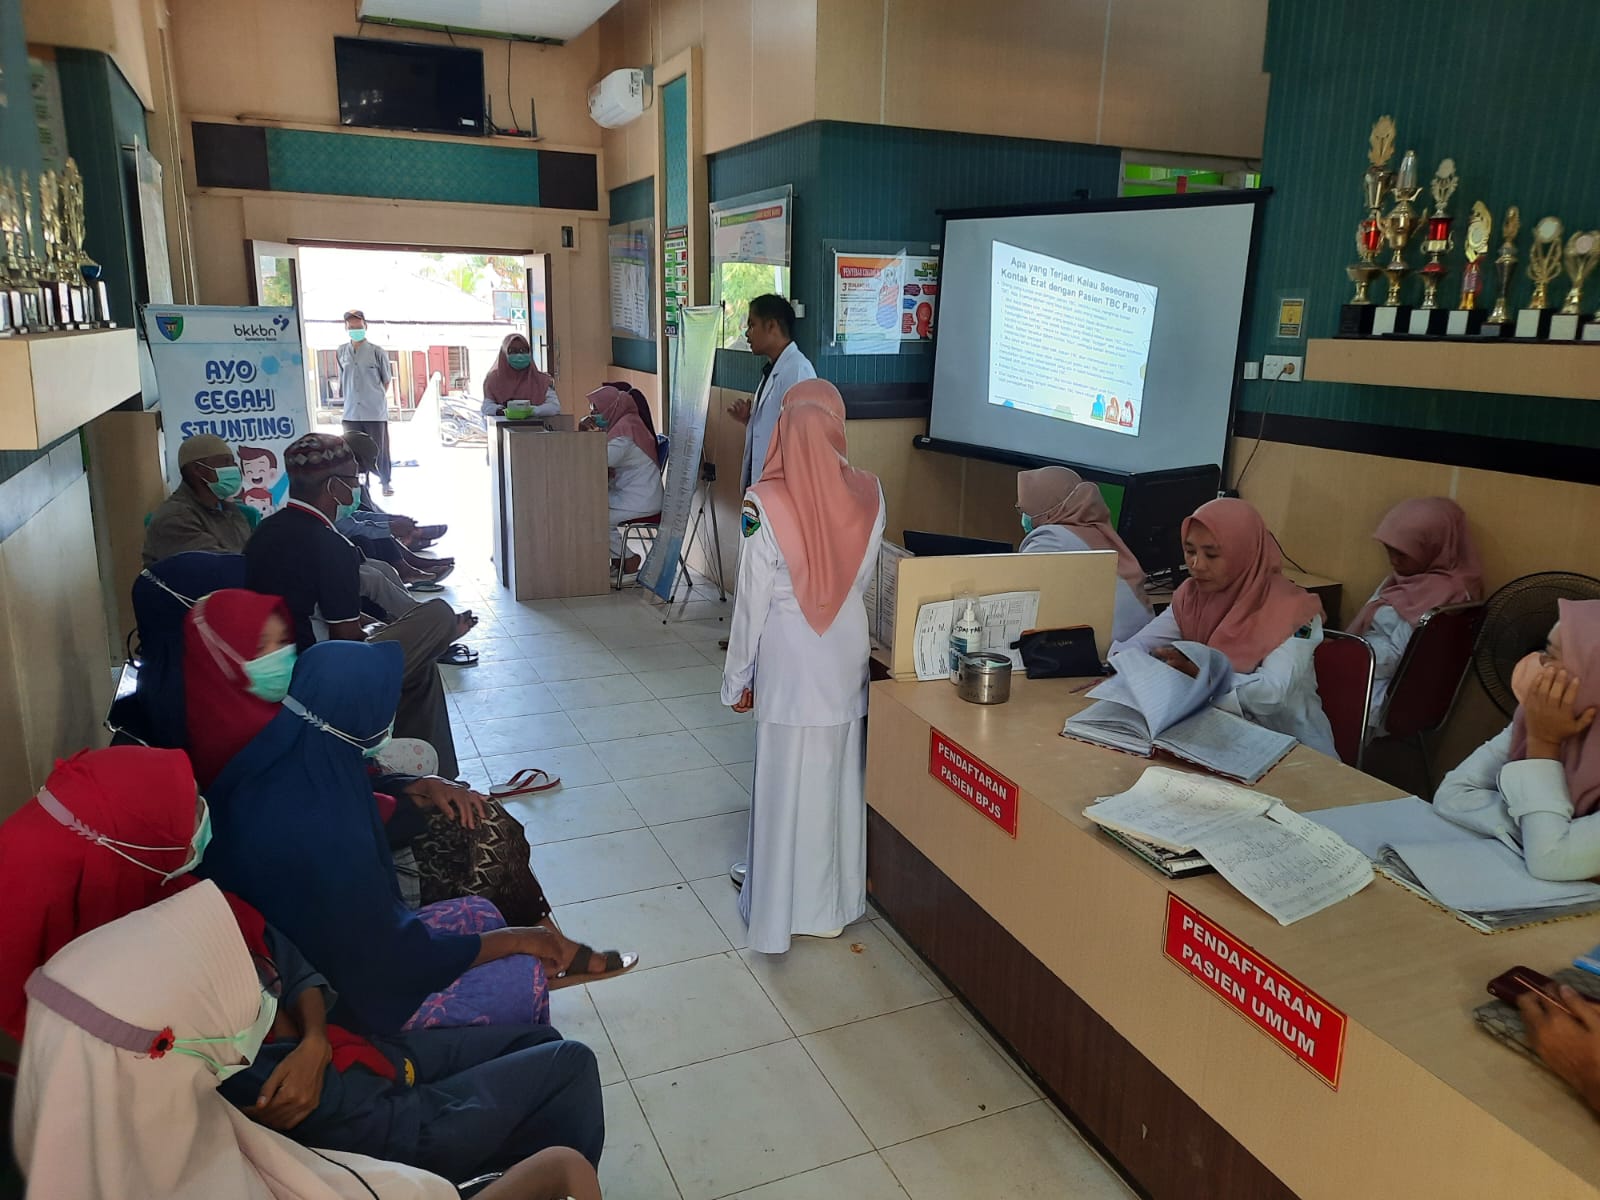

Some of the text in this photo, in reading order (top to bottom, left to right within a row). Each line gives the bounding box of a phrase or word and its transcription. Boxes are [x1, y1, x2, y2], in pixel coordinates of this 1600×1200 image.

[1001, 268, 1028, 284] Kontak
[1030, 276, 1047, 289] Erat
[1048, 283, 1076, 299] dengan
[1078, 290, 1103, 305] Pasien
[1105, 297, 1121, 310] TBC
[1122, 302, 1140, 314] Paru
[1010, 257, 1139, 303] Apa yang Terjadi Kalau Seseorang
[234, 324, 277, 337] bkkbn
[205, 360, 255, 382] AYO
[194, 389, 274, 412] CEGAH
[181, 417, 293, 441] STUNTING
[938, 742, 1007, 800] PENDAFTARAN
[941, 765, 1001, 819] PASIEN BPJS
[1182, 915, 1322, 1029] PENDAFTARAN
[1182, 944, 1315, 1057] PASIEN UMUM
